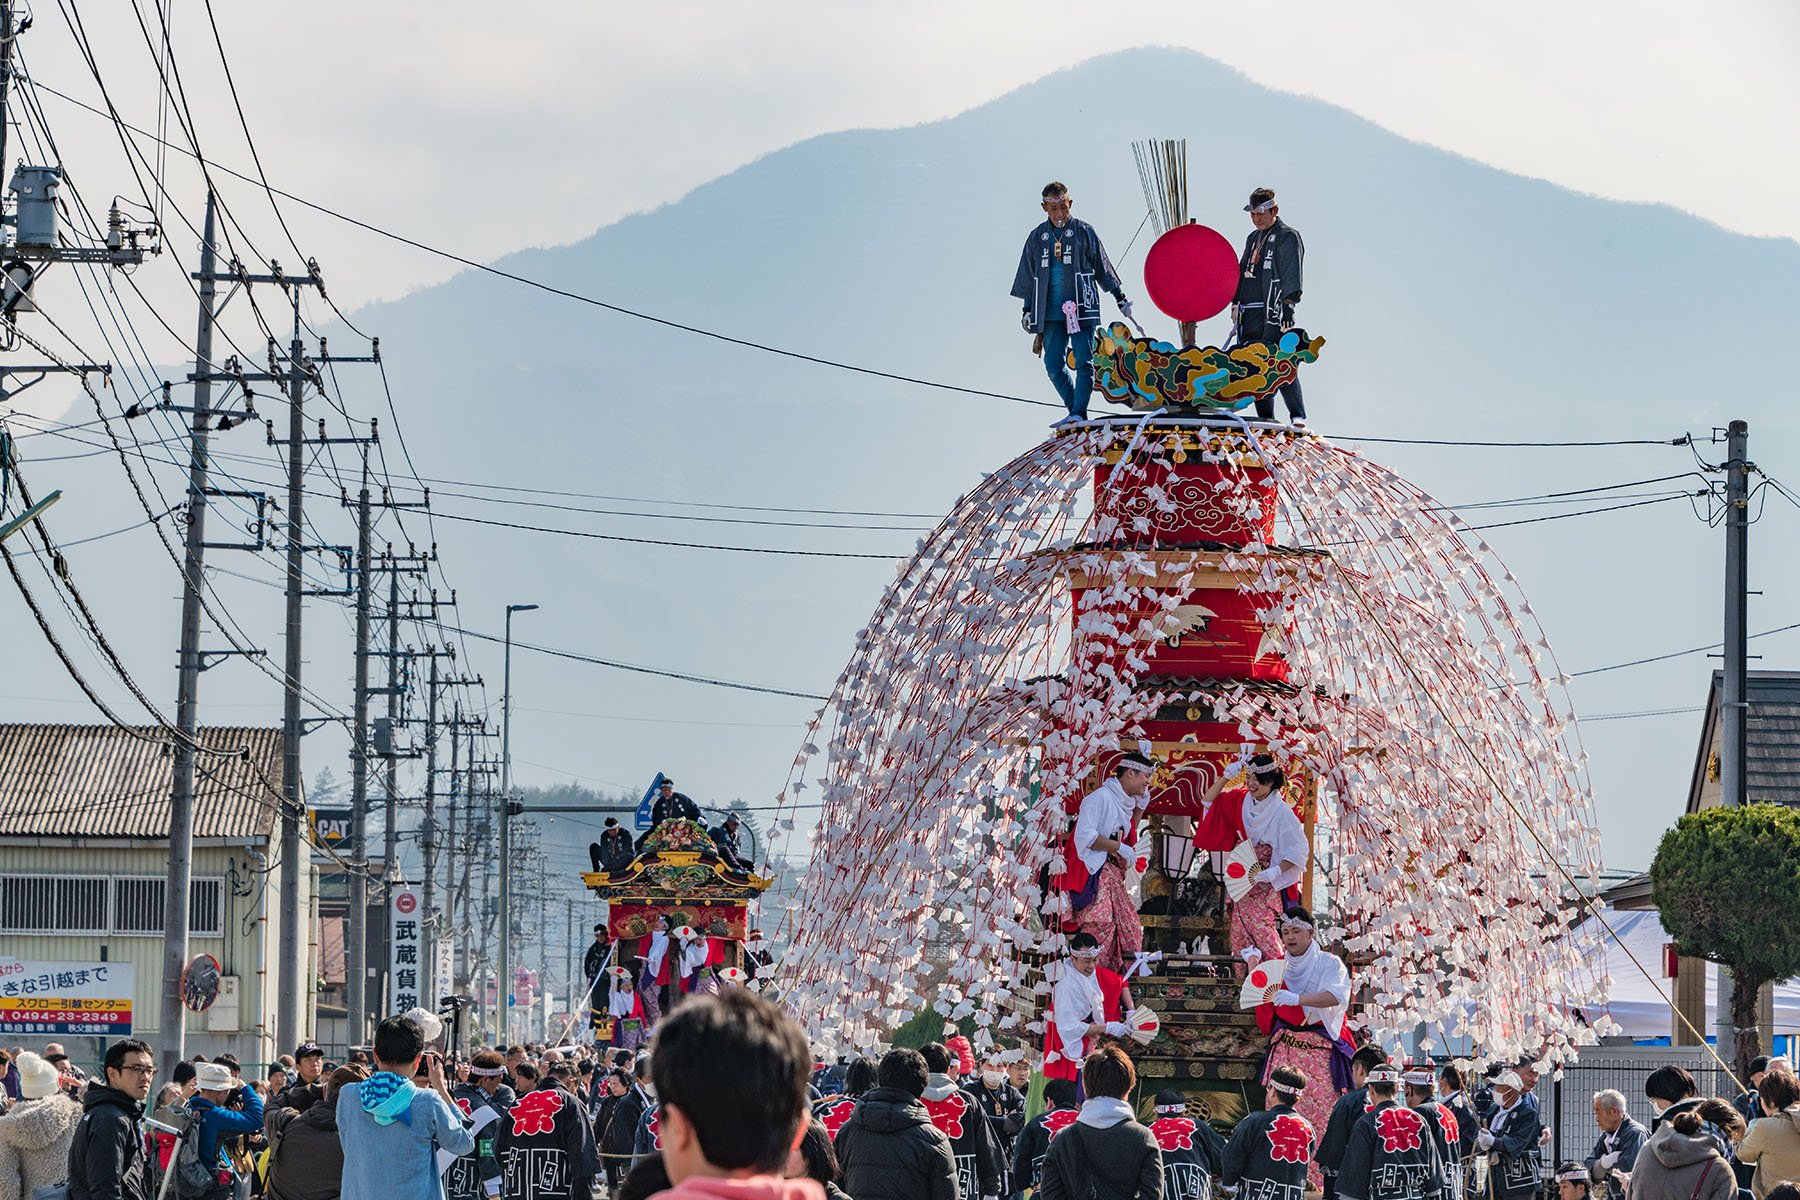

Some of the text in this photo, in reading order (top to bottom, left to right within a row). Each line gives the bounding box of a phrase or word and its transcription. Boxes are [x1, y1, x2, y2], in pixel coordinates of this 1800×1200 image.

[318, 819, 349, 840] CAT
[396, 920, 418, 1014] 武蔵貨物
[0, 967, 108, 998] きな引越まで
[16, 999, 127, 1009] スワロー引越センター
[11, 1011, 118, 1021] 0494-23-2349
[1379, 1072, 1390, 1081] 上
[1428, 1073, 1435, 1083] 上
